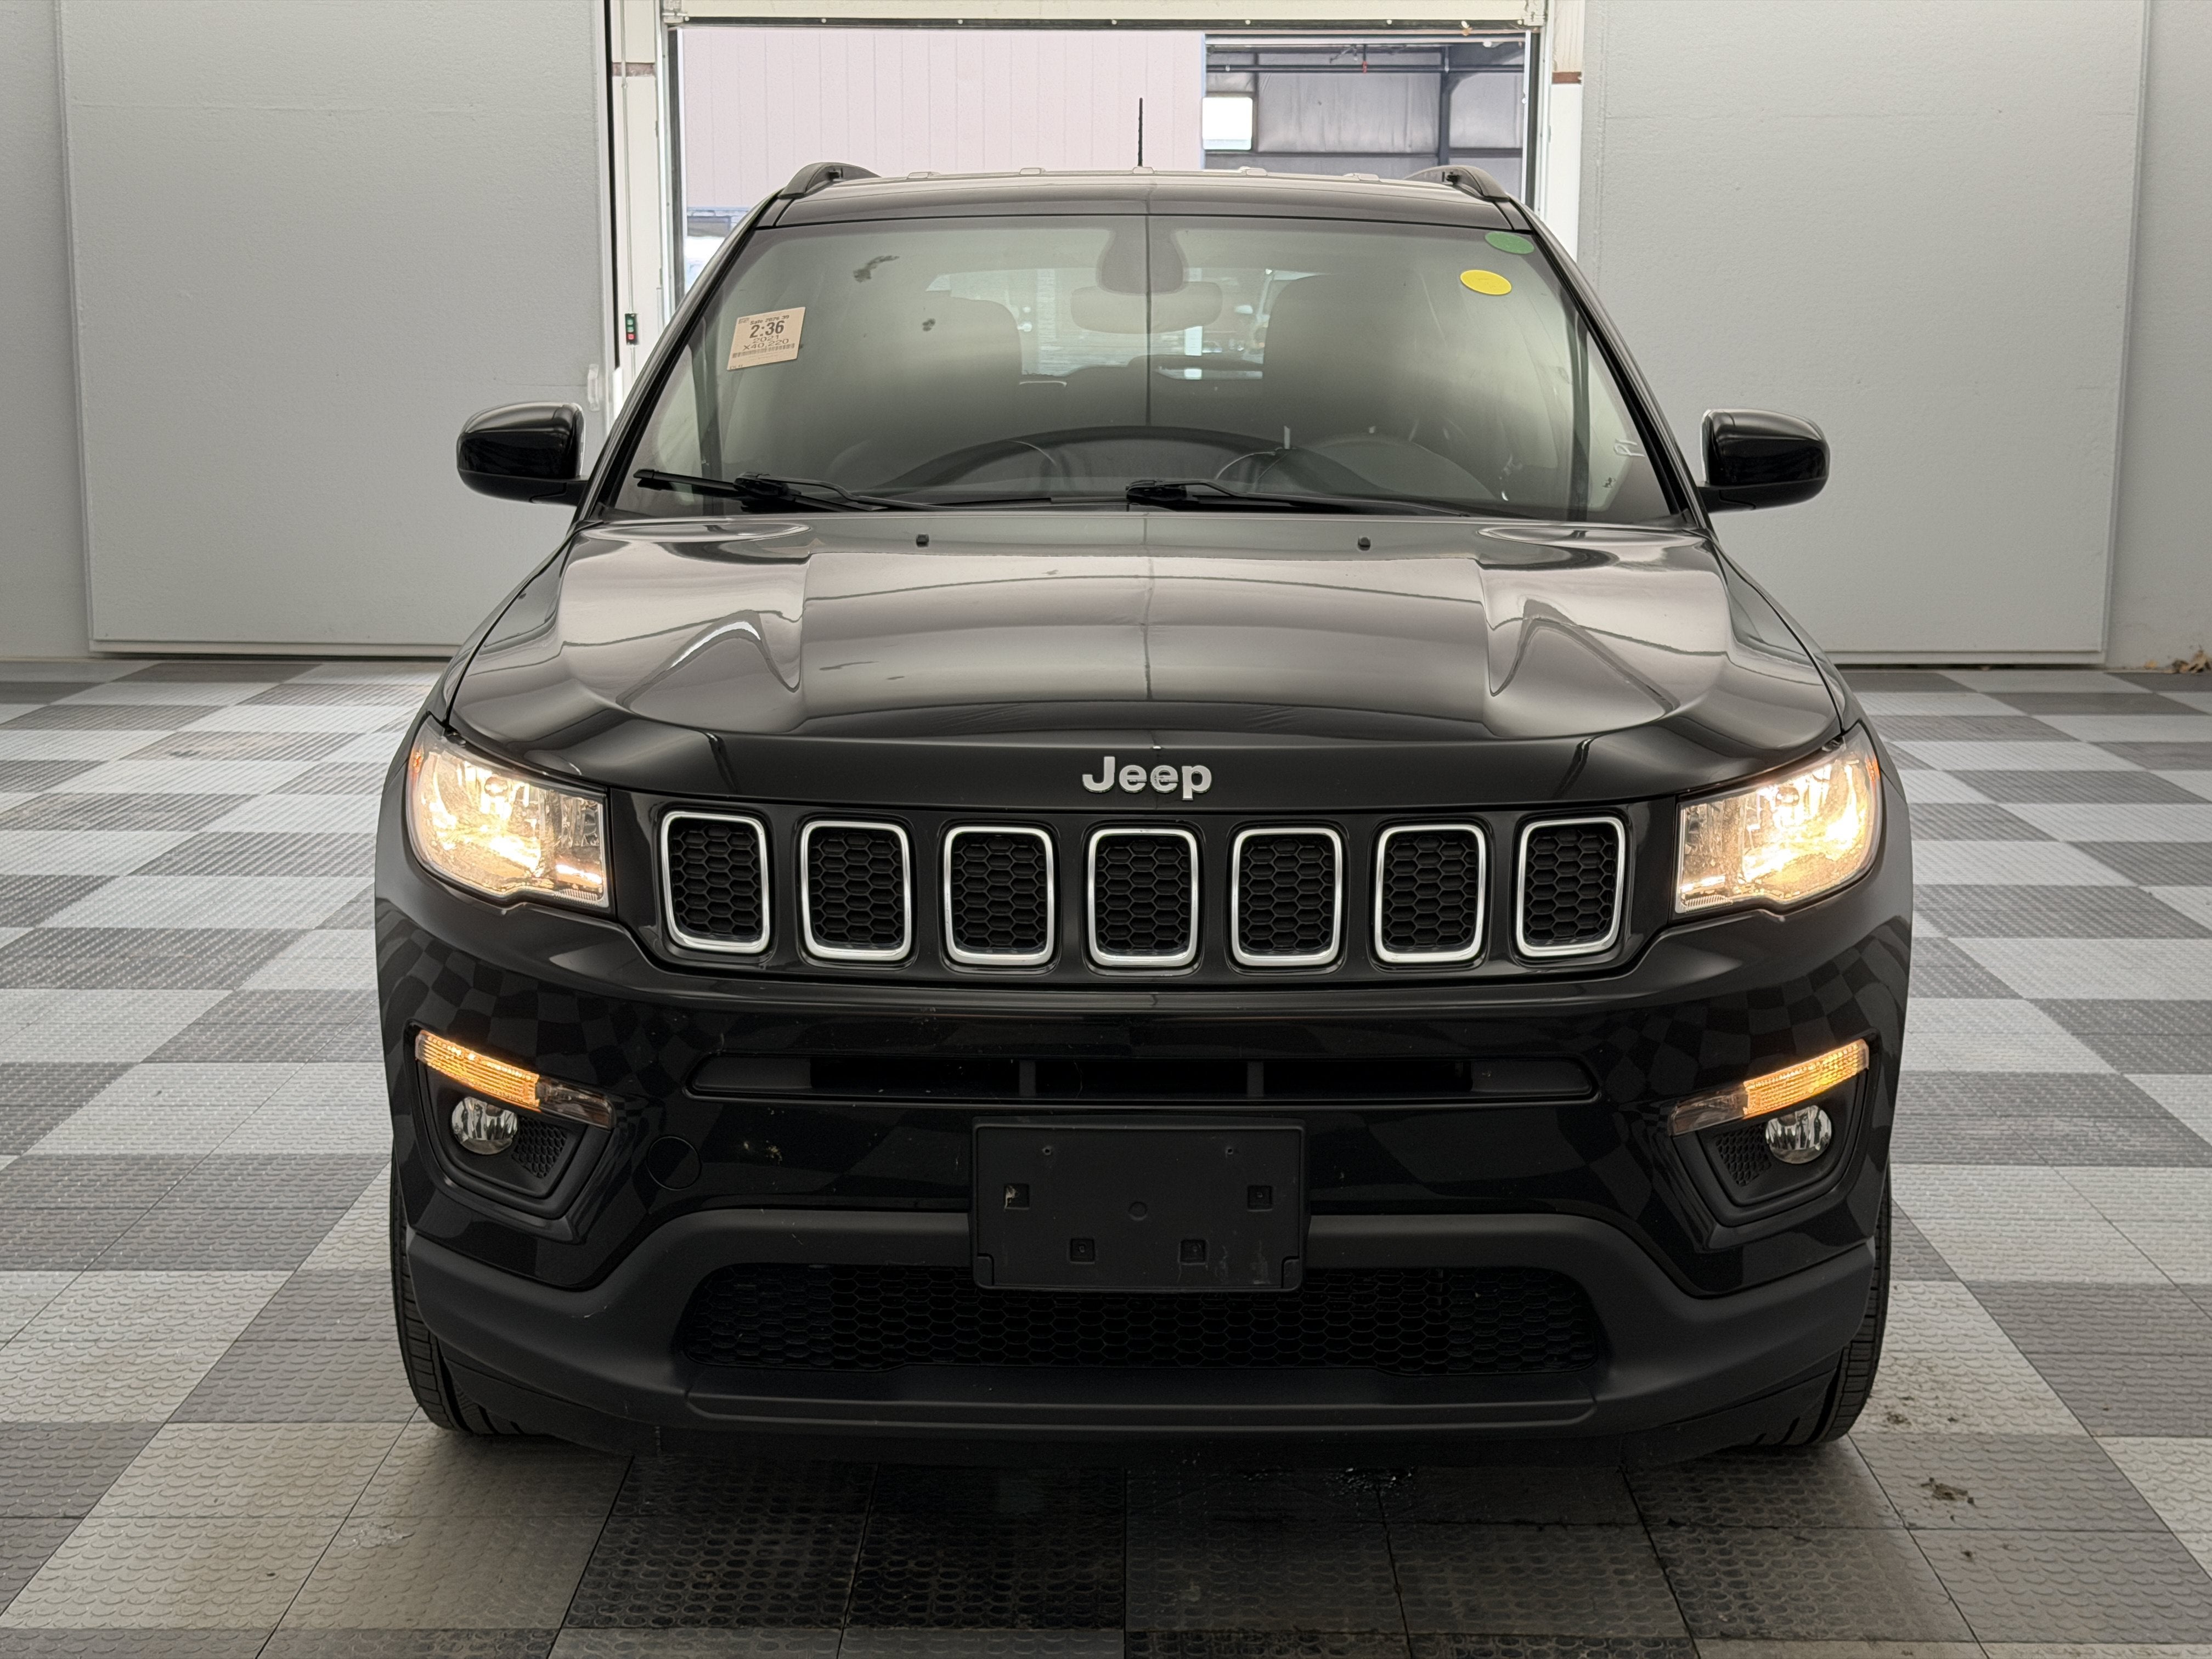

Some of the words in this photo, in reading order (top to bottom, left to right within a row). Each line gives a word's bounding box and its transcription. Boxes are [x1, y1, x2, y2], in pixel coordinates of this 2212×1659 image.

[749, 320, 785, 338] 2:36
[753, 335, 778, 343] 2021
[1082, 756, 1212, 800] Jeep
